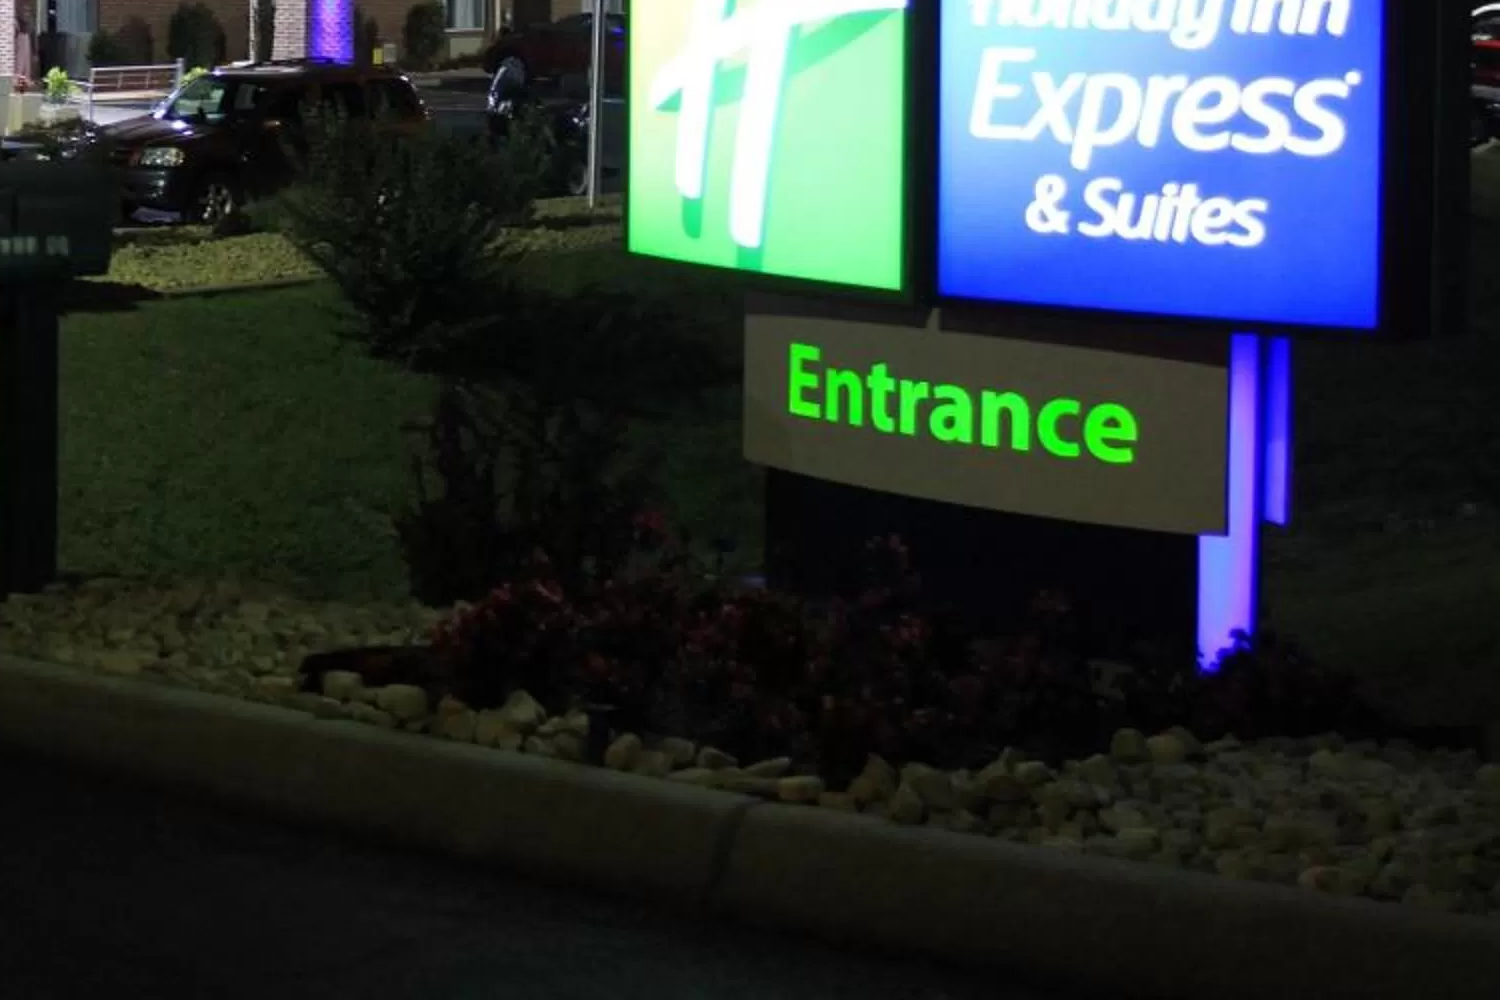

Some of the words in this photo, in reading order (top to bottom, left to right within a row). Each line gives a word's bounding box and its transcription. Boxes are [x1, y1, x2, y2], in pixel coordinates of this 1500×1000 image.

[969, 46, 1347, 170] Express
[1025, 174, 1071, 234] &
[1077, 176, 1269, 247] Suites
[789, 343, 1139, 464] Entrance
